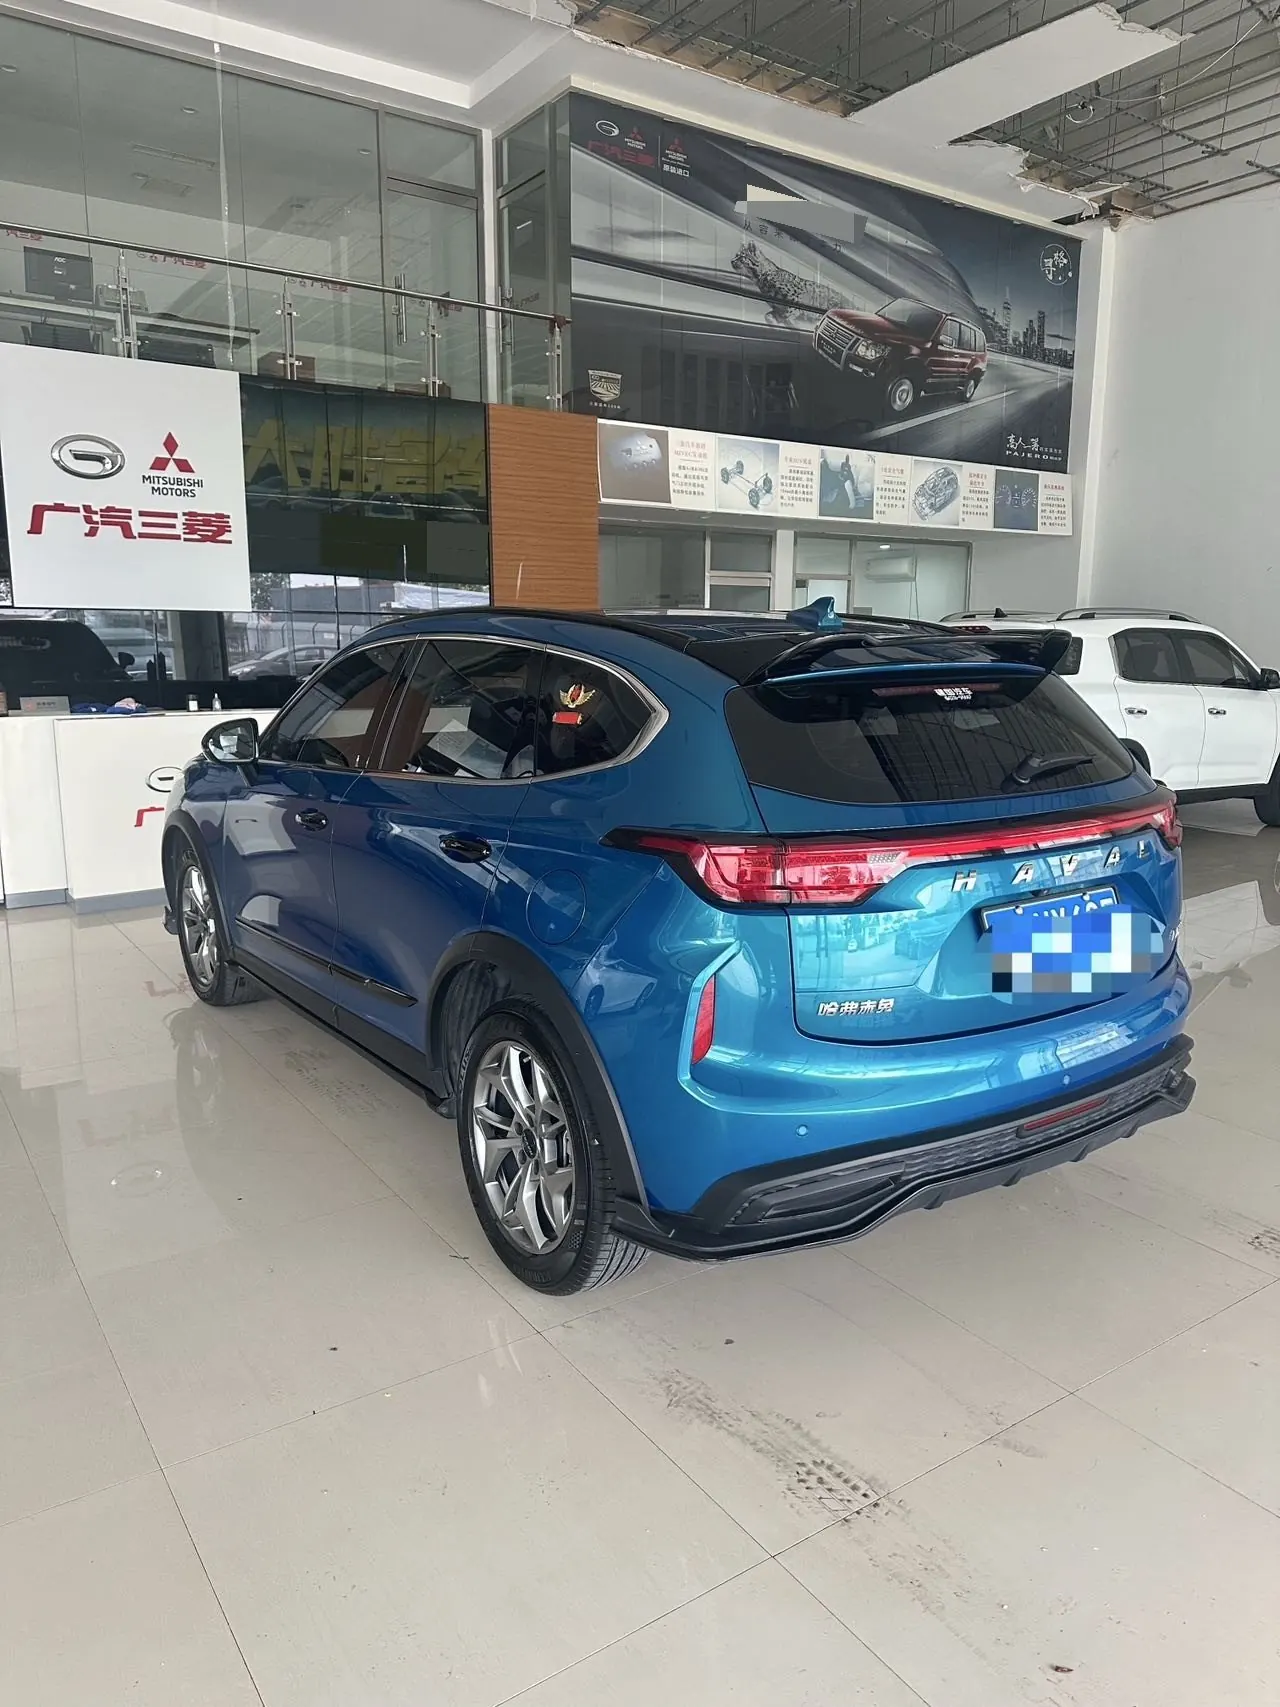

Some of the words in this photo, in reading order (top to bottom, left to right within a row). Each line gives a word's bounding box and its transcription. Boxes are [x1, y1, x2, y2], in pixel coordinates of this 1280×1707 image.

[1006, 450, 1049, 460] PAJERO
[142, 474, 204, 488] MITSUBISHI
[151, 486, 197, 498] MOTORS
[27, 502, 233, 544] 广汽三菱
[951, 839, 1149, 892] HAVAL
